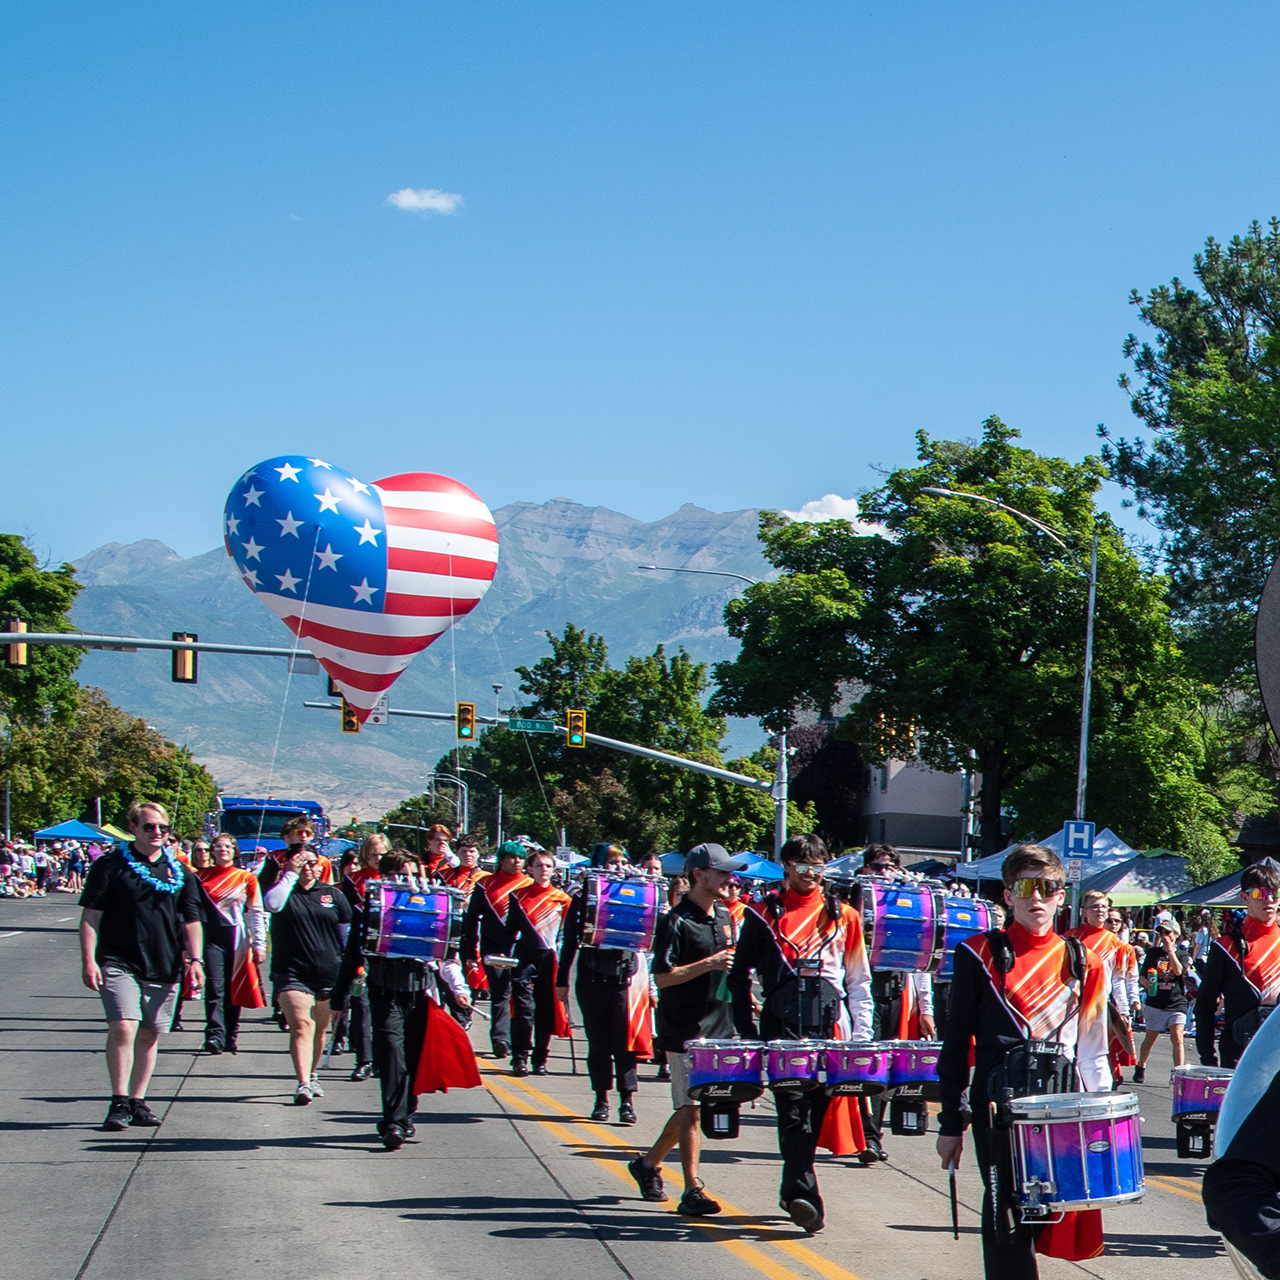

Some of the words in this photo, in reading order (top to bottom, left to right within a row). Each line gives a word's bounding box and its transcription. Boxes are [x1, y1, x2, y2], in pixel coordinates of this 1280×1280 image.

[1068, 823, 1090, 849] H
[704, 1085, 733, 1097] Pearl
[896, 1084, 923, 1096] Pearl
